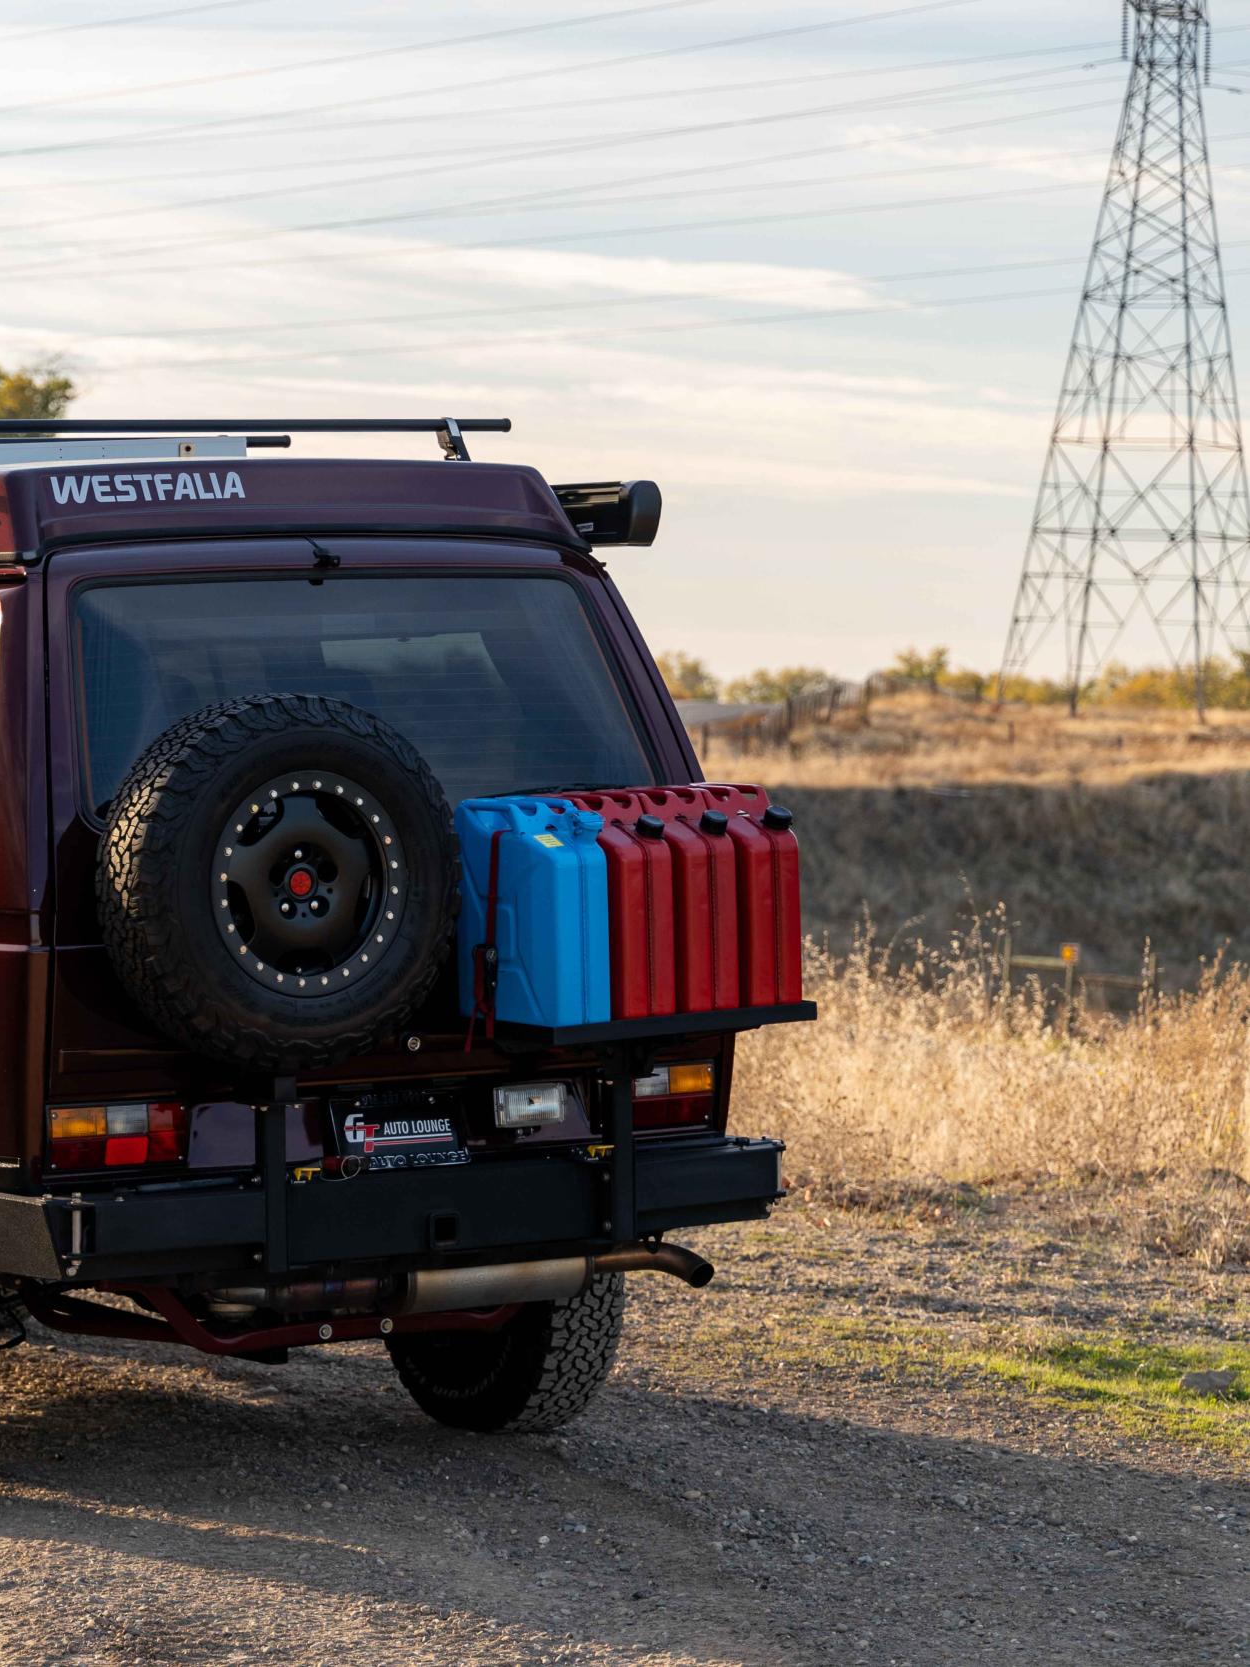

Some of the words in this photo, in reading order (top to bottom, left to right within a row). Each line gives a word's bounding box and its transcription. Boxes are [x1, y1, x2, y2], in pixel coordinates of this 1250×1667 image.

[50, 471, 246, 505] WESTFALIA
[344, 1113, 380, 1153] GT
[383, 1120, 409, 1135] AUTO
[411, 1118, 451, 1134] LOUNGE
